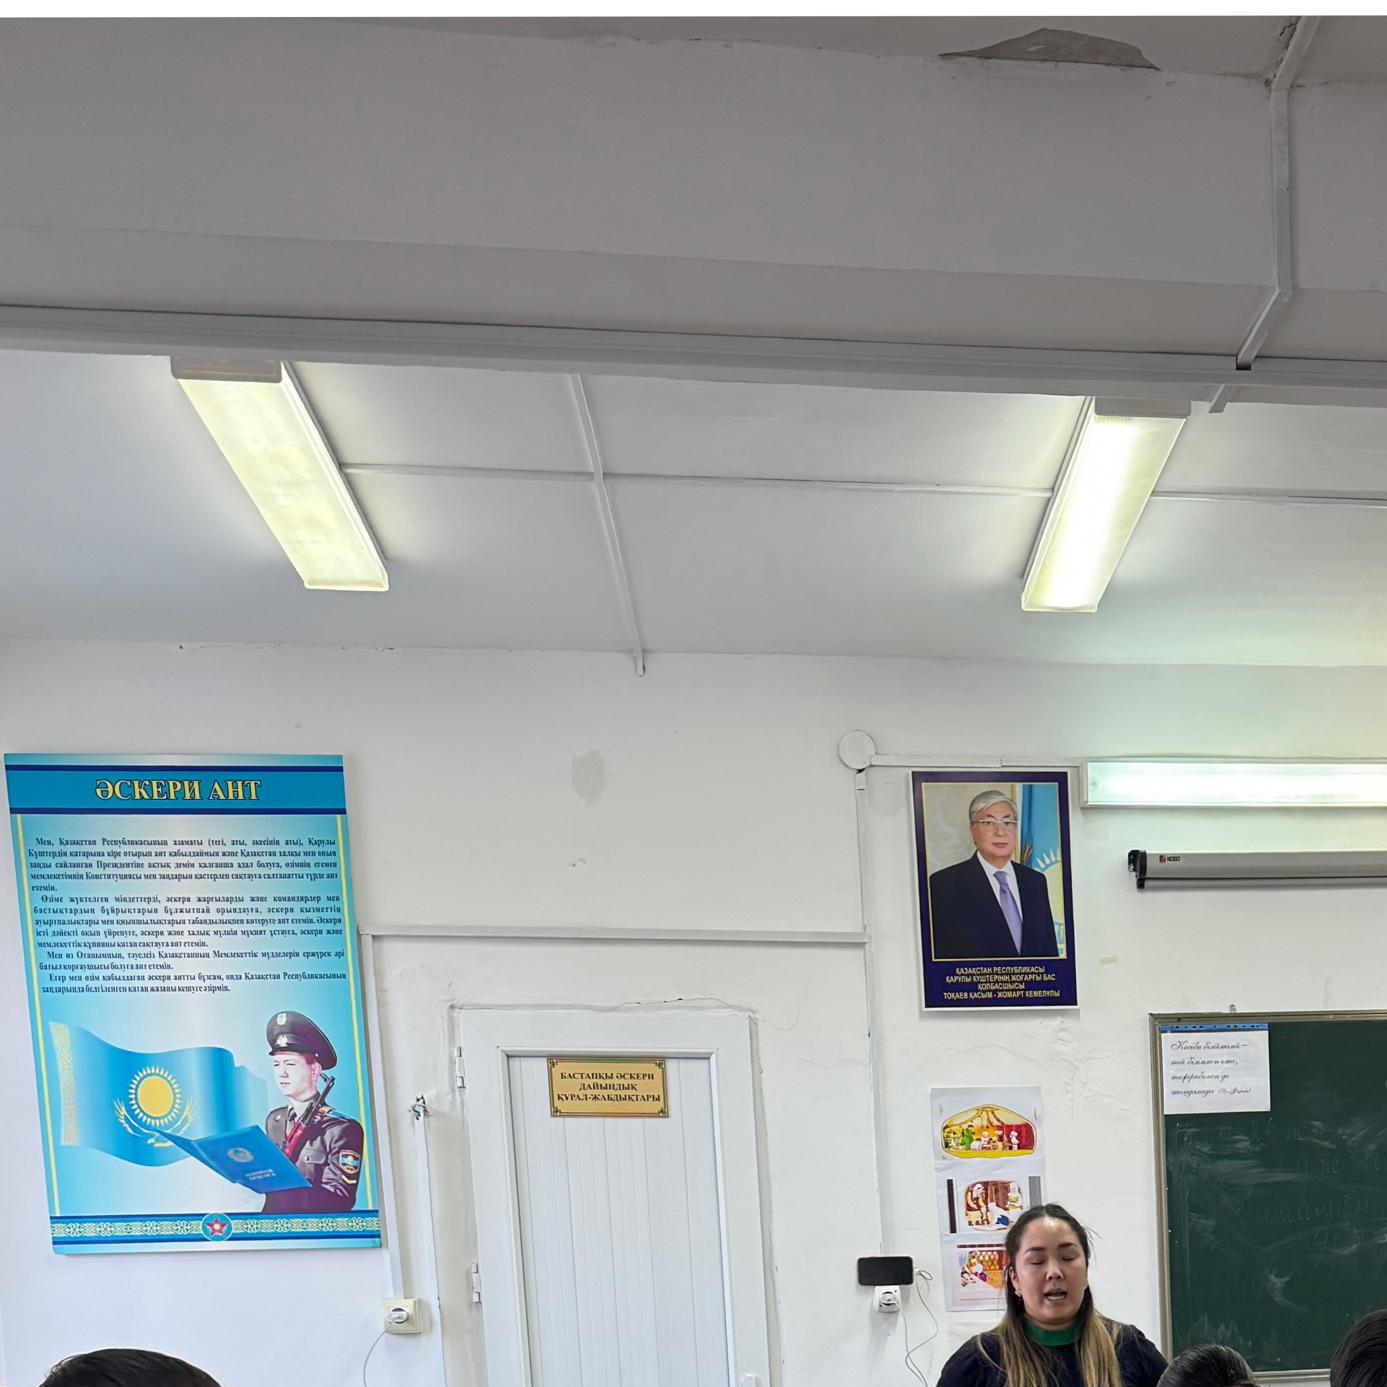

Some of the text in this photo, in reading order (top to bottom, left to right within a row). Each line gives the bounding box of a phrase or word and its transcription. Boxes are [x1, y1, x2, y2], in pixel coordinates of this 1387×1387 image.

[95, 779, 261, 801] ӘСКЕРИ АНТ
[956, 967, 992, 975] ҚАЗАҚСТАН
[561, 1072, 613, 1082] БАСТАПҚЫ
[579, 1082, 637, 1092] ДАЙЫНДЫҚ
[557, 1093, 660, 1102] ҚҰРАЛ-ЖАБДЫҚТАРЫ
